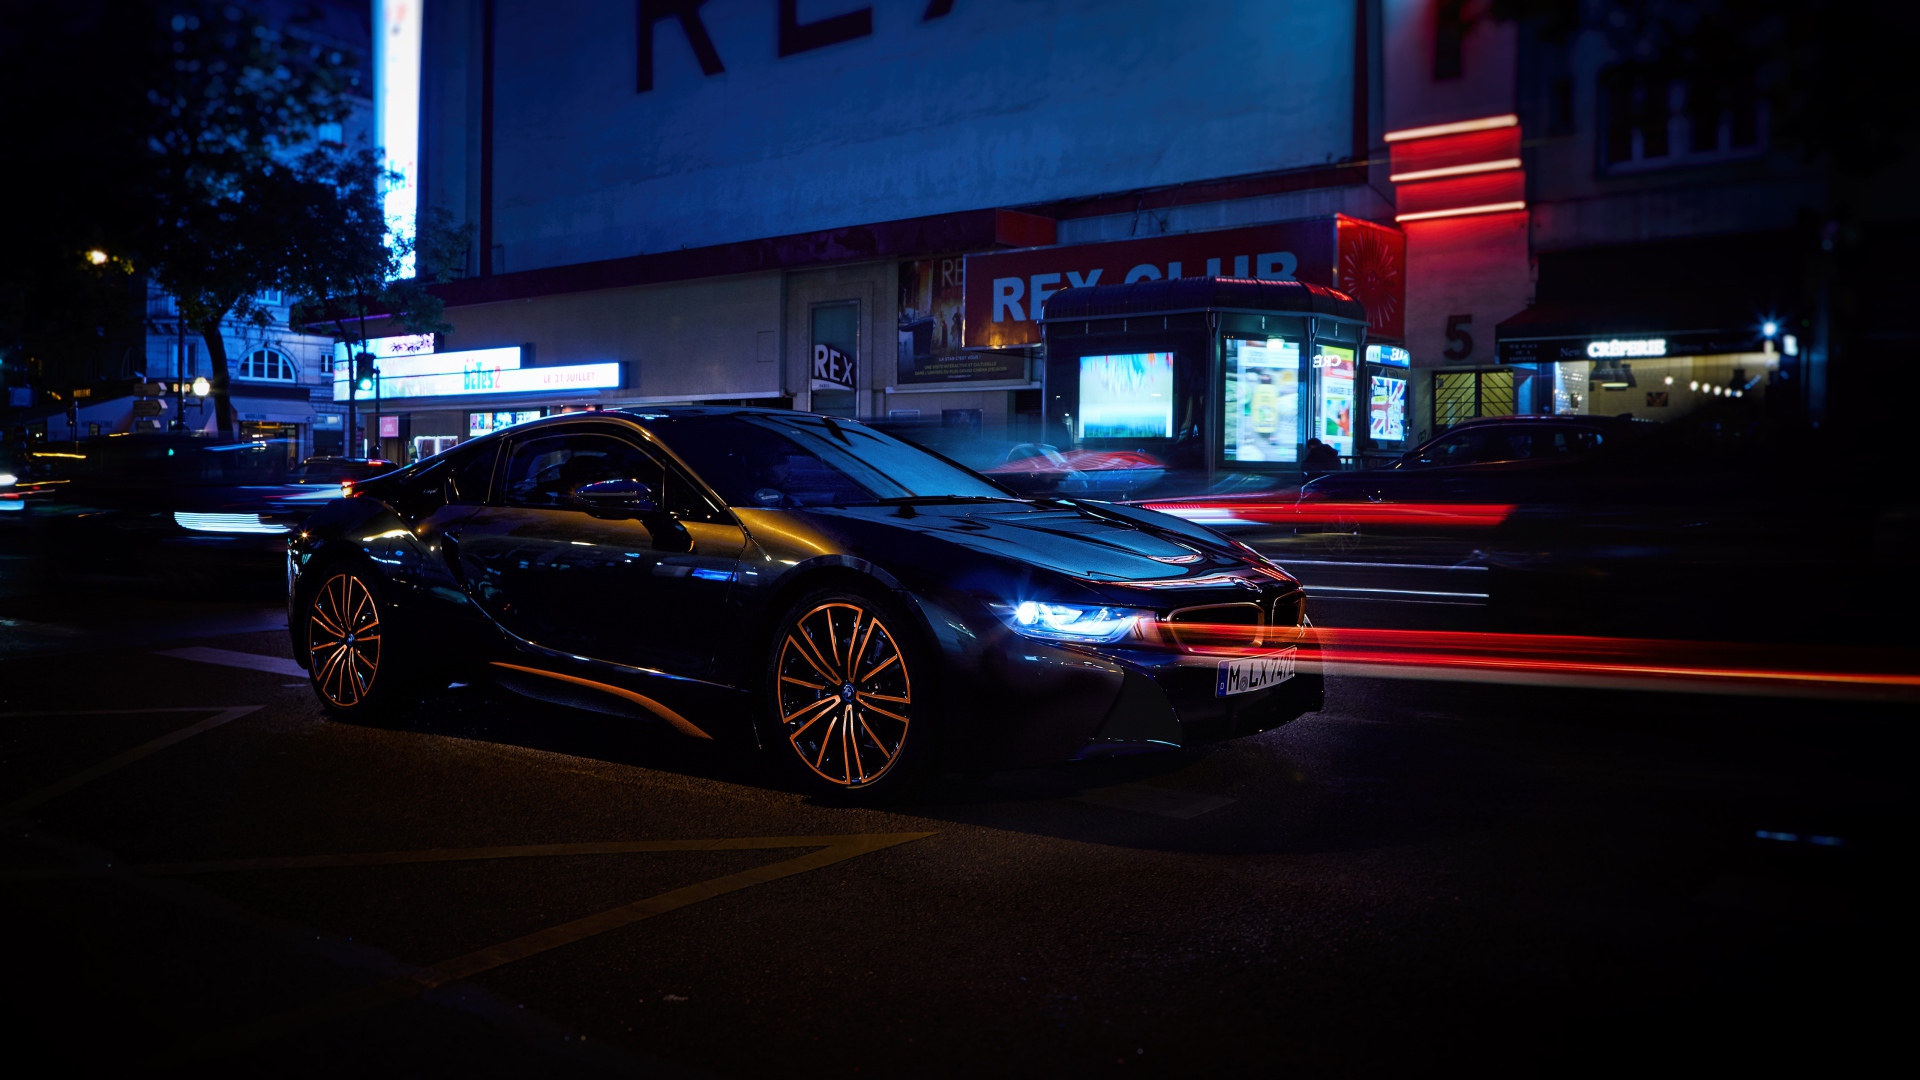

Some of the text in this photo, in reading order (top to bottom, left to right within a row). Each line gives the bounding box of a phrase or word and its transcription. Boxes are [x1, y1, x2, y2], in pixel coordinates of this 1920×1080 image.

[941, 257, 963, 287] RE
[1443, 314, 1473, 360] 5
[543, 374, 551, 384] LE
[566, 372, 596, 382] JUILLET
[814, 344, 853, 385] REX
[172, 383, 191, 393] BR
[1228, 664, 1241, 692] M
[1249, 660, 1269, 688] LX
